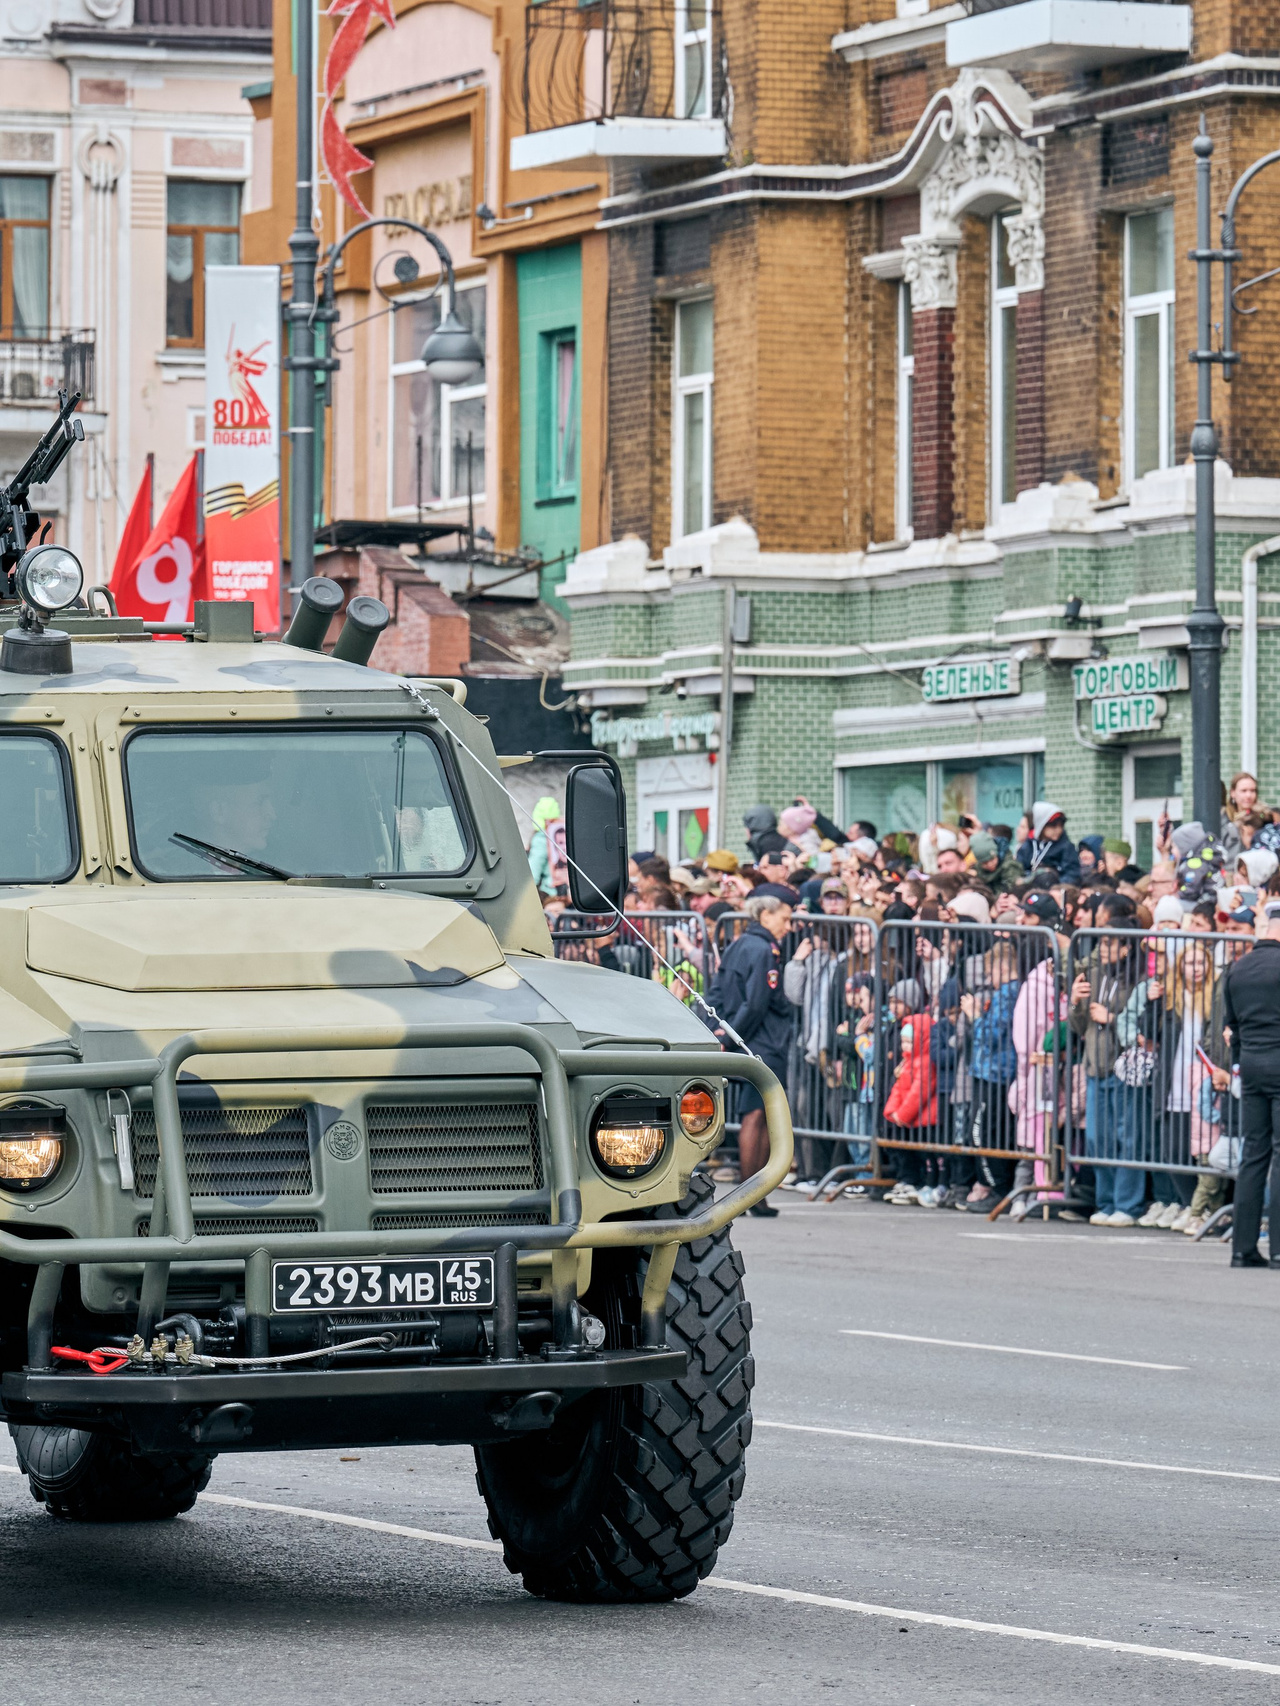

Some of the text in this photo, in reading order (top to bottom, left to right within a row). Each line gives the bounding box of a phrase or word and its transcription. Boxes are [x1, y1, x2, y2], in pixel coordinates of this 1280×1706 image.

[214, 399, 244, 427] 80
[213, 430, 272, 447] ПОБЕДА!
[925, 663, 1008, 697] ЗЕЛЕНЫЕ
[1093, 699, 1155, 734] ЦЕНТР
[289, 1261, 481, 1306] 2393 МВ 45
[450, 1291, 477, 1302] RUS
